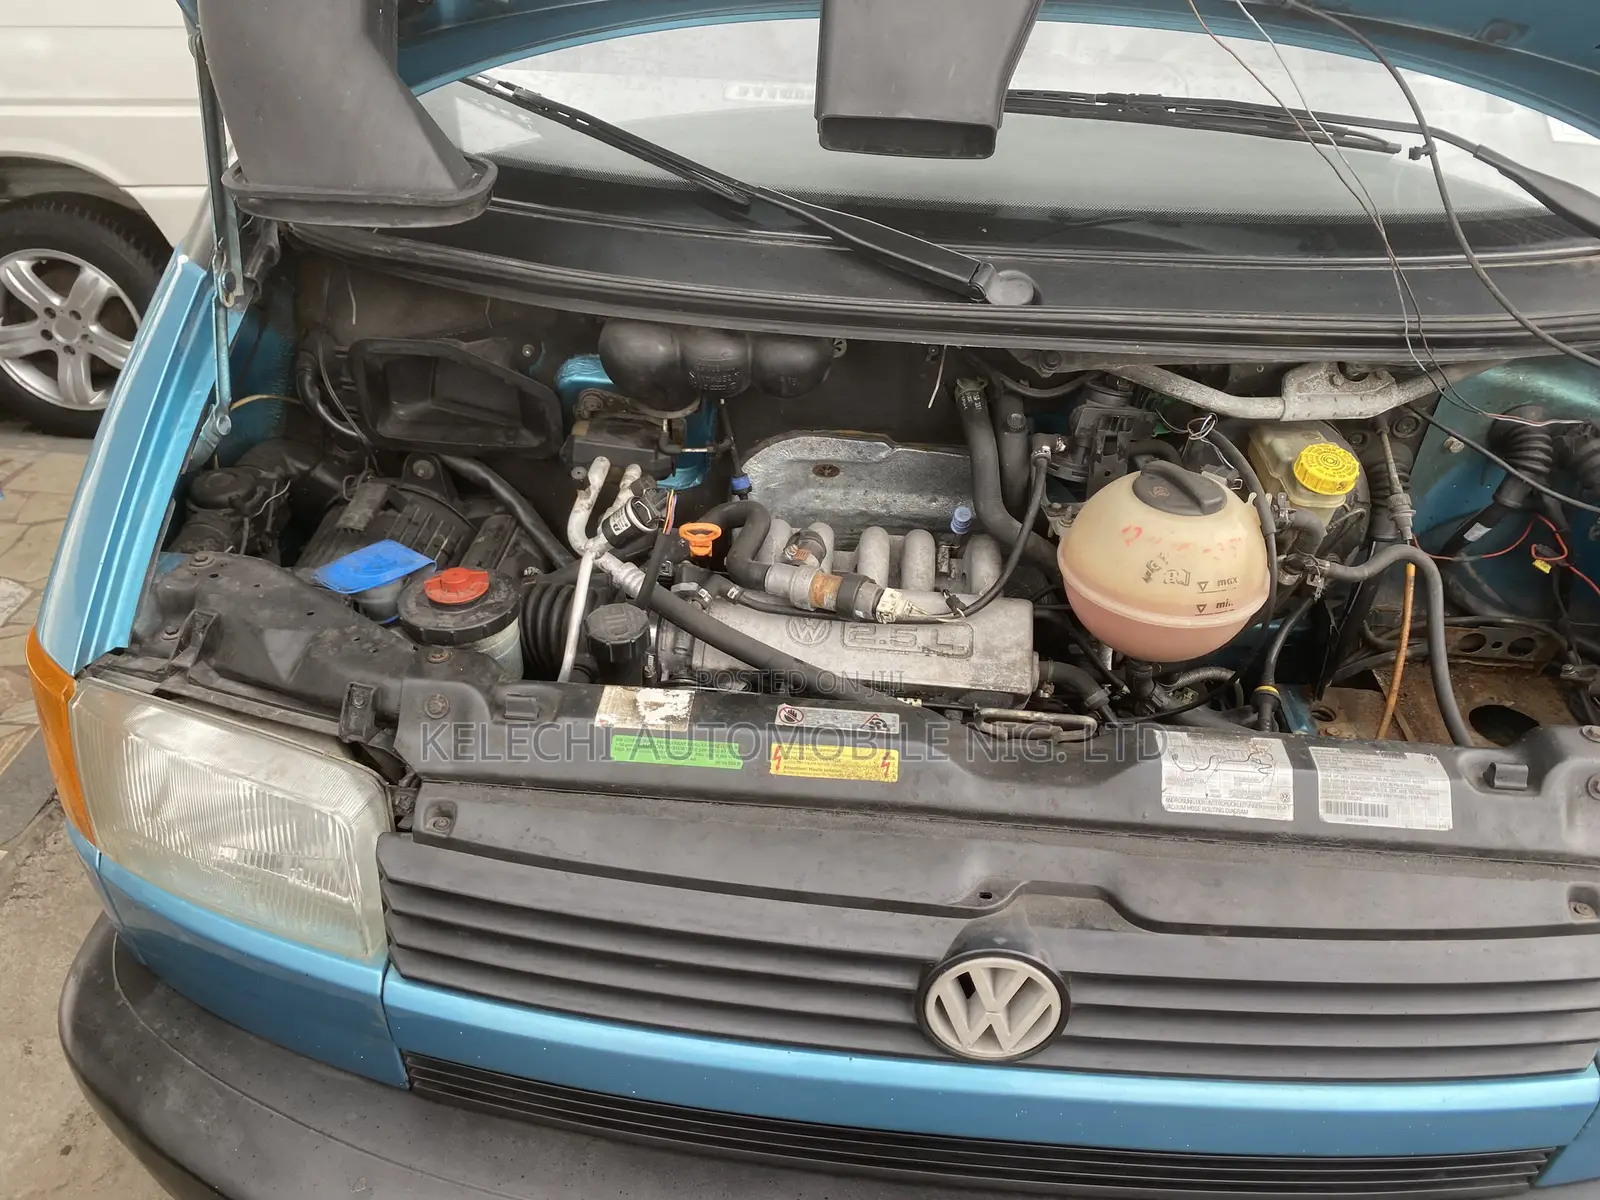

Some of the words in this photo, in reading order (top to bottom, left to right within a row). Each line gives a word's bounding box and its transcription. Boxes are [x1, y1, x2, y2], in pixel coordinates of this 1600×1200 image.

[1217, 577, 1238, 586] max
[785, 613, 833, 648] VW
[925, 957, 1061, 1061] VW
